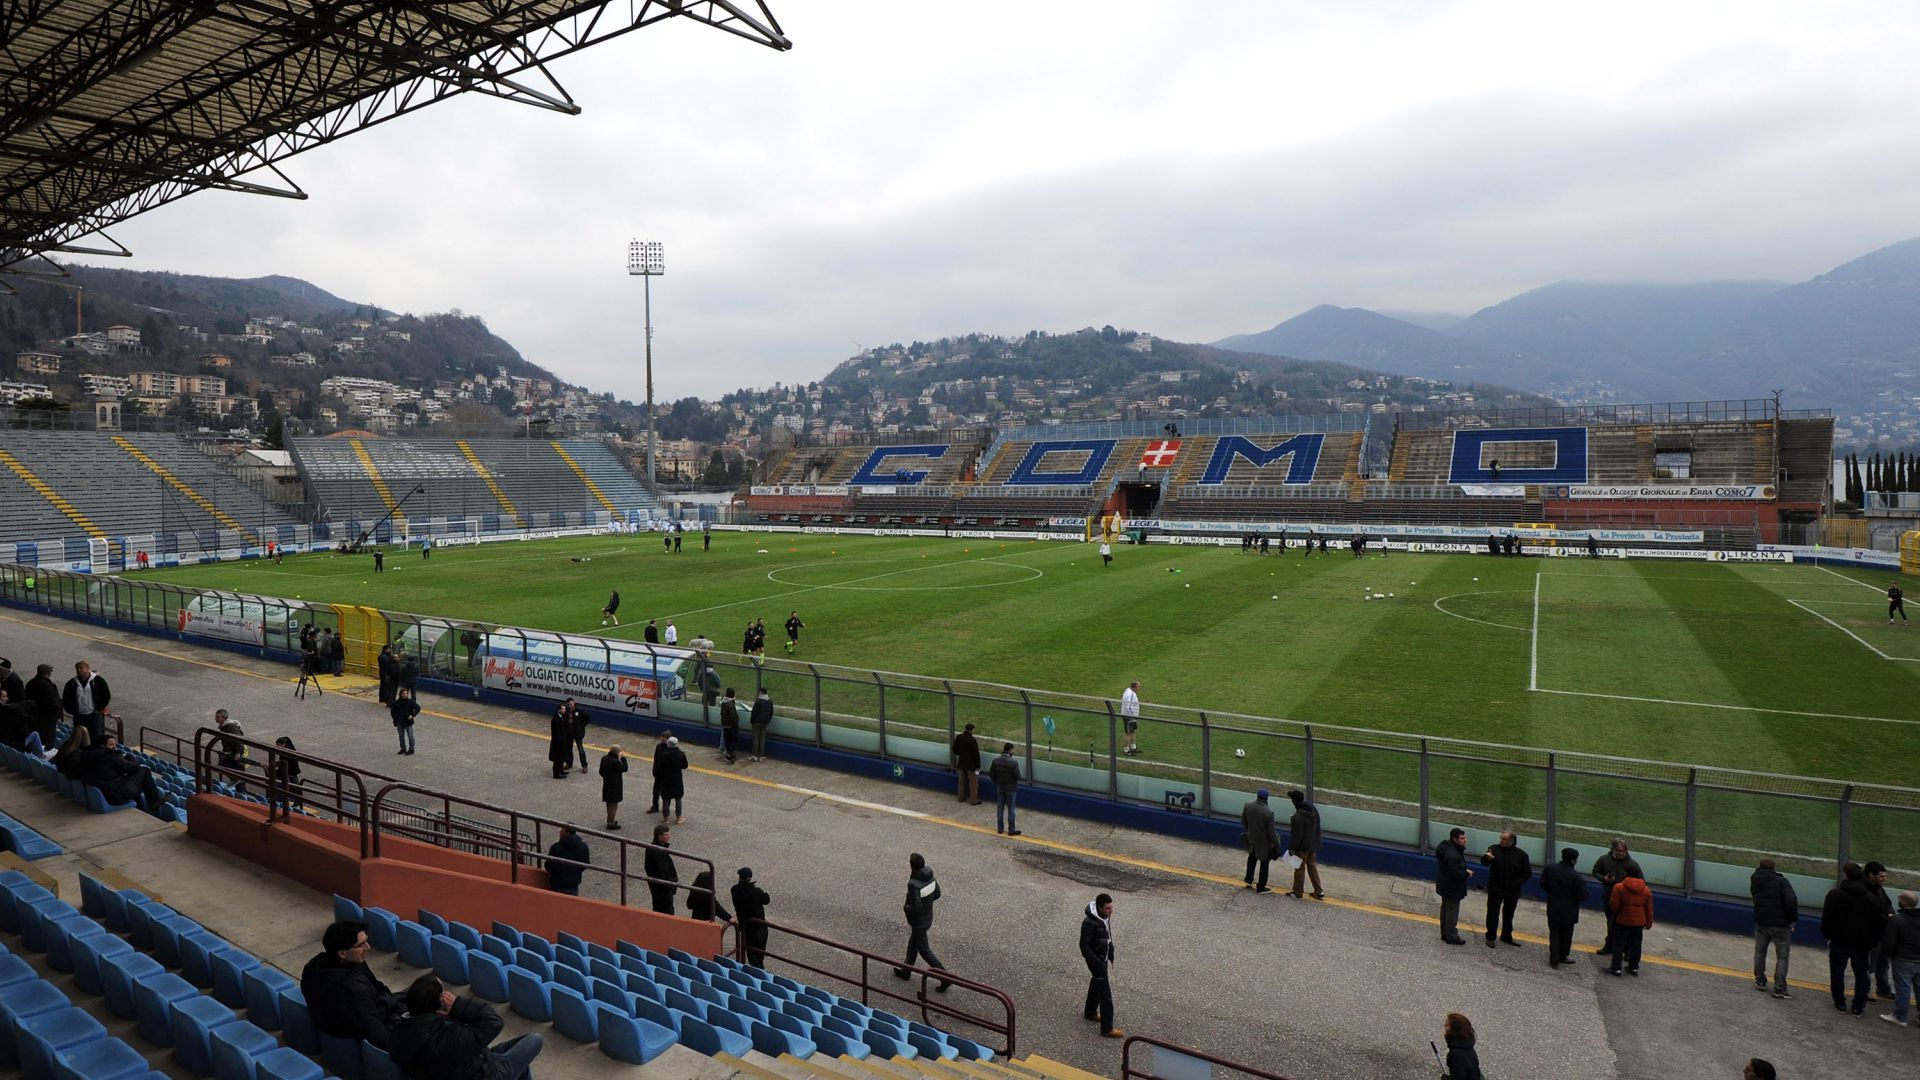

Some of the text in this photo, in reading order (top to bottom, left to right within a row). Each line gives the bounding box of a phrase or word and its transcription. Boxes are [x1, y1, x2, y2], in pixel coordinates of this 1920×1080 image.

[1640, 488, 1680, 496] GIORNALE
[1690, 488, 1713, 496] ERBA
[530, 654, 607, 671] www.crcantu.it
[526, 667, 615, 691] OLGIATE COMASCO
[526, 682, 616, 703] www.giem-mondomoda.it
